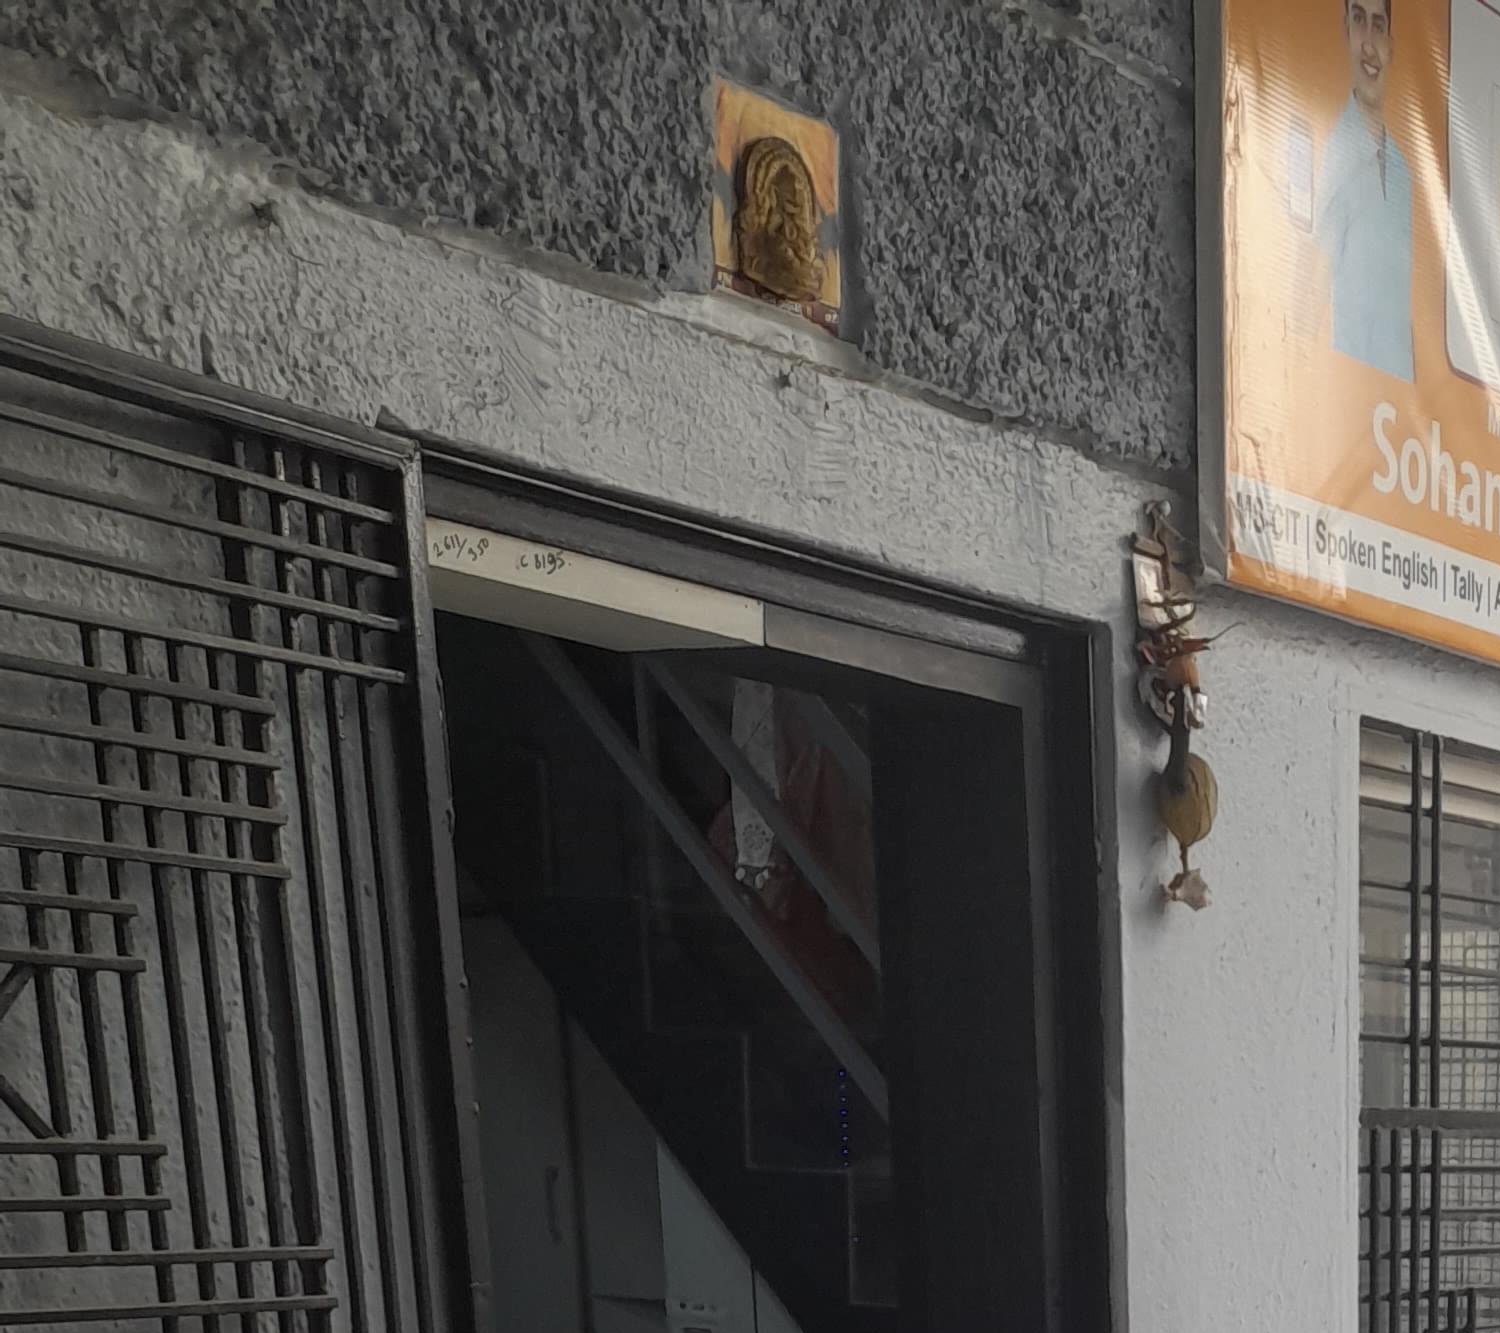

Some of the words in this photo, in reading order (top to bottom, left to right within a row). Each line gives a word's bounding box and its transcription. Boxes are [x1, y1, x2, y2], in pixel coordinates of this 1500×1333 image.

[1315, 518, 1377, 571] Spoken
[1381, 541, 1438, 591] English
[1450, 564, 1484, 613] Tally
